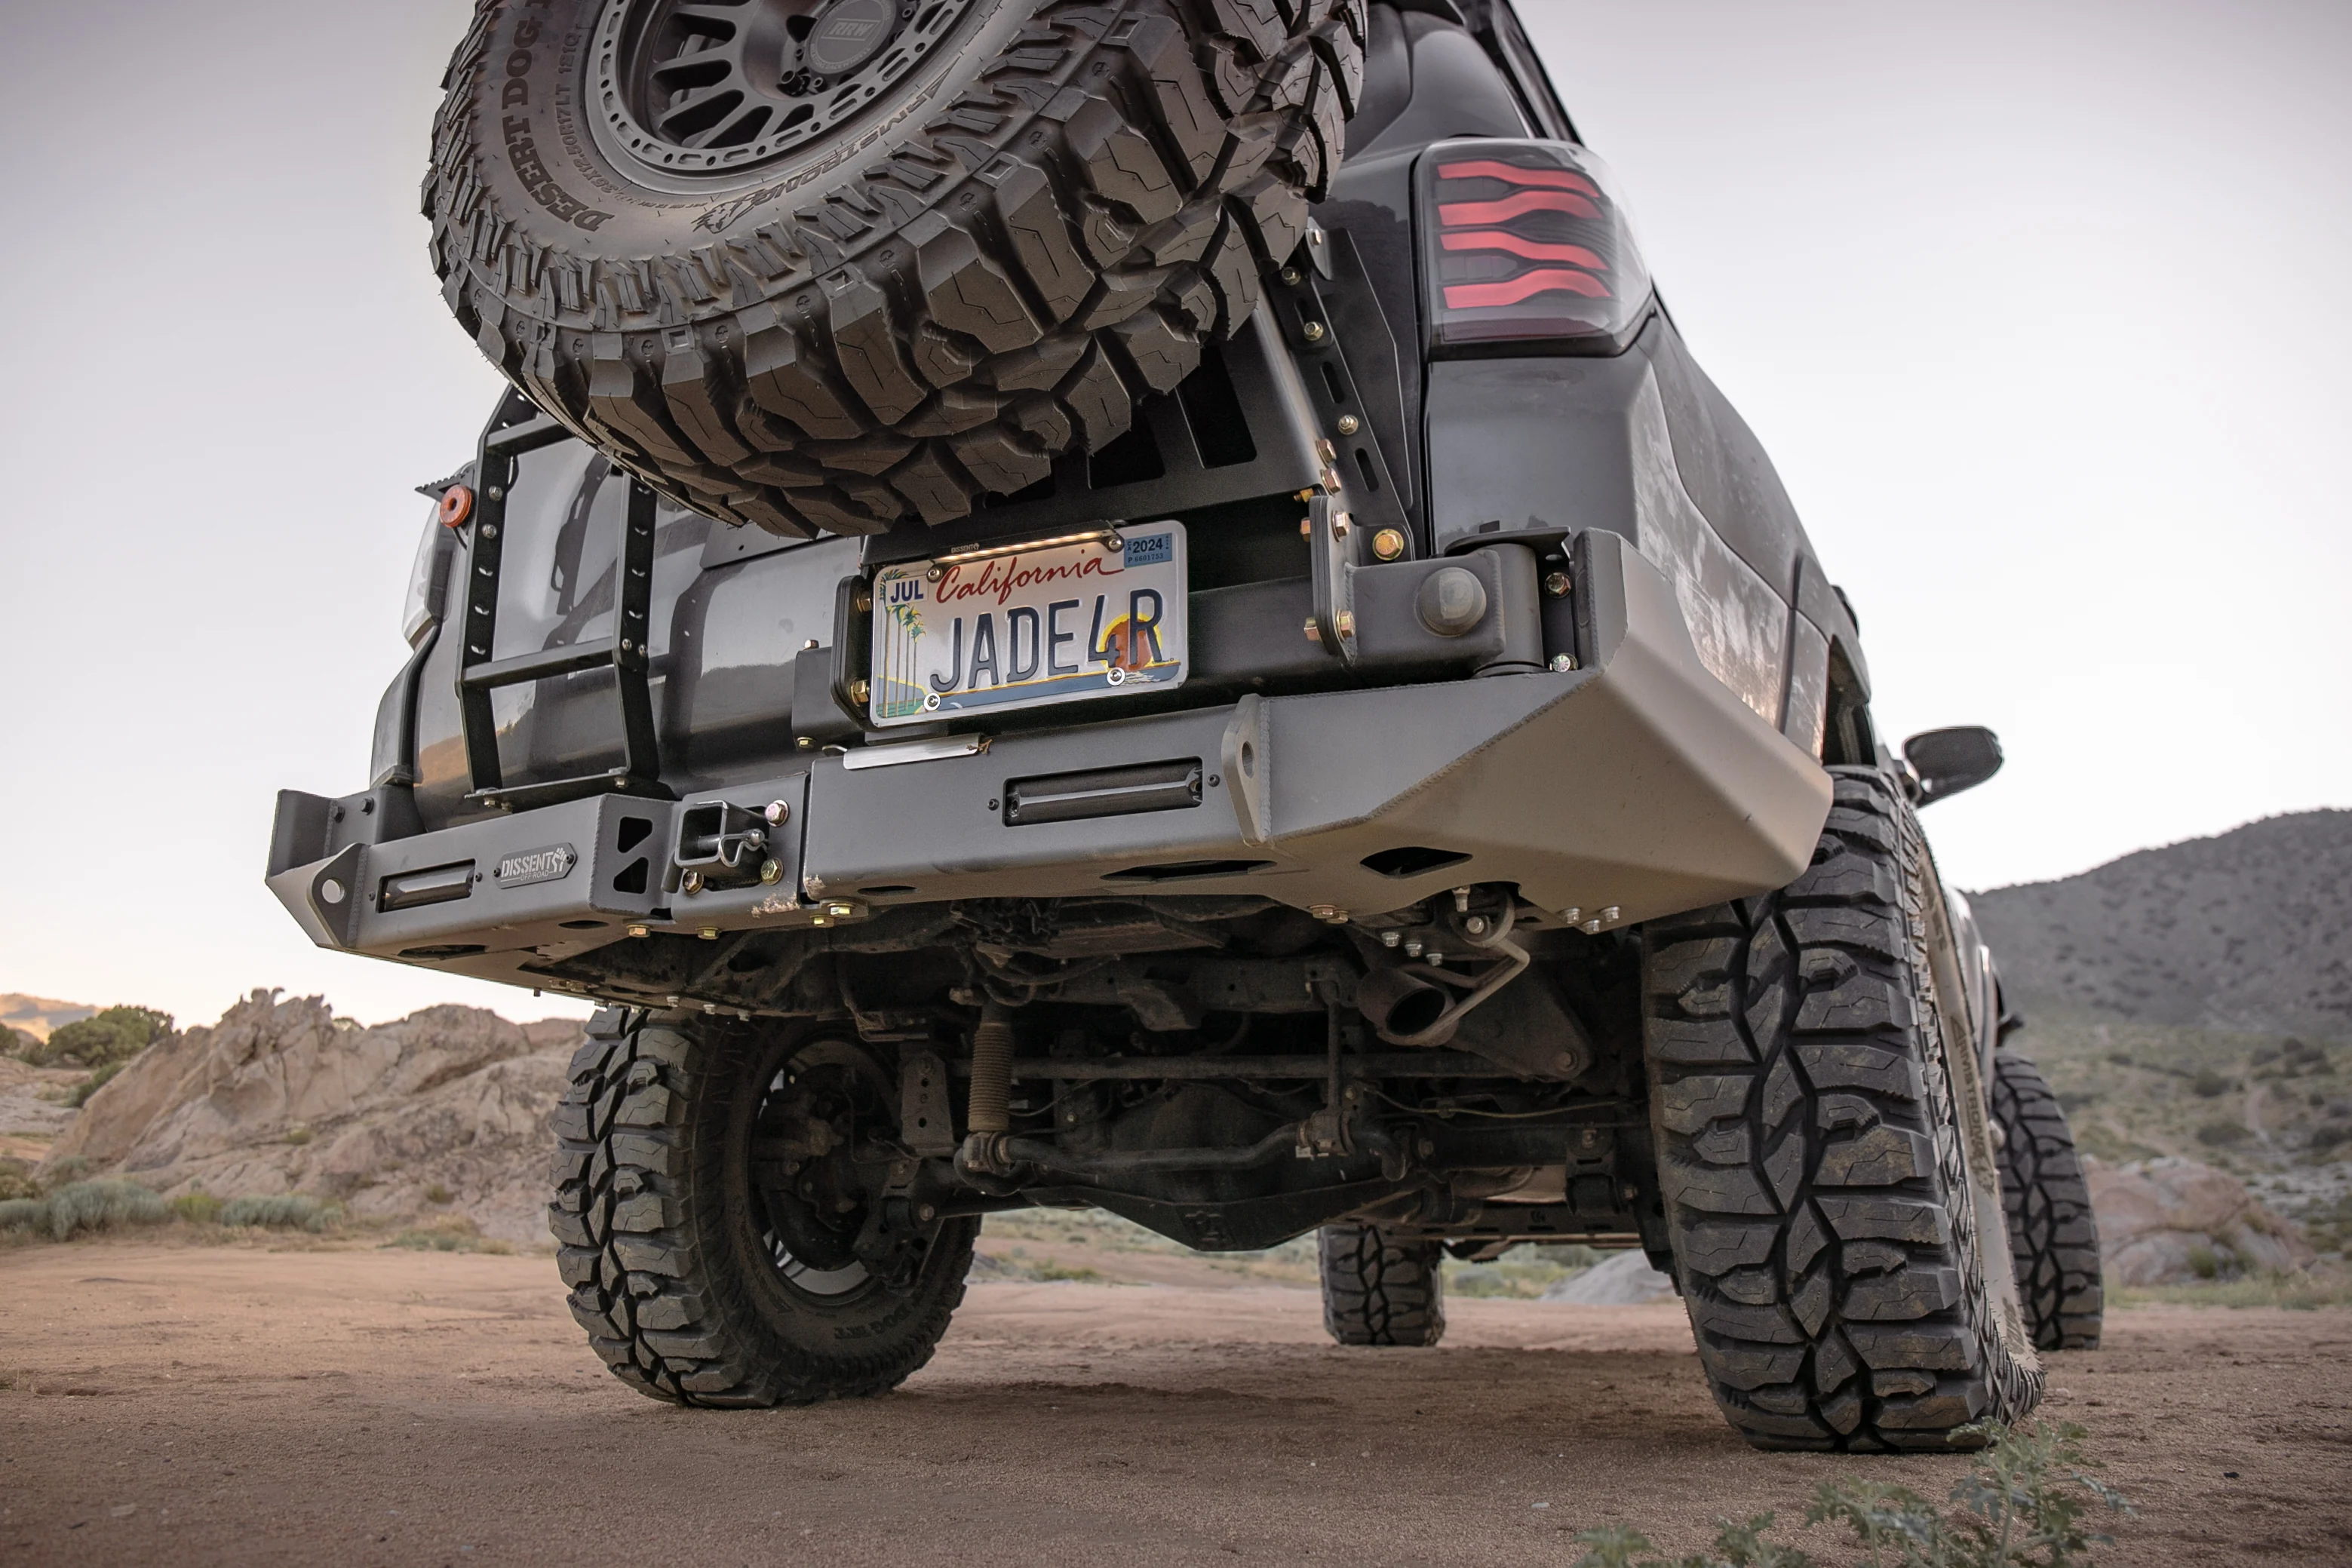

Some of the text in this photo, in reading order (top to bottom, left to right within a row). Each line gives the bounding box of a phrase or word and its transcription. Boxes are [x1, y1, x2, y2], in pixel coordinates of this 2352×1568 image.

[829, 22, 874, 37] RRW
[502, 16, 616, 232] DESERT DOG
[754, 56, 962, 207] ARMSTRONG
[951, 544, 974, 554] DISSENT
[1133, 538, 1163, 554] 2024
[890, 579, 924, 603] JUL
[935, 549, 1125, 606] California
[929, 588, 1165, 692] JADE4R
[501, 851, 554, 878] DISSENT
